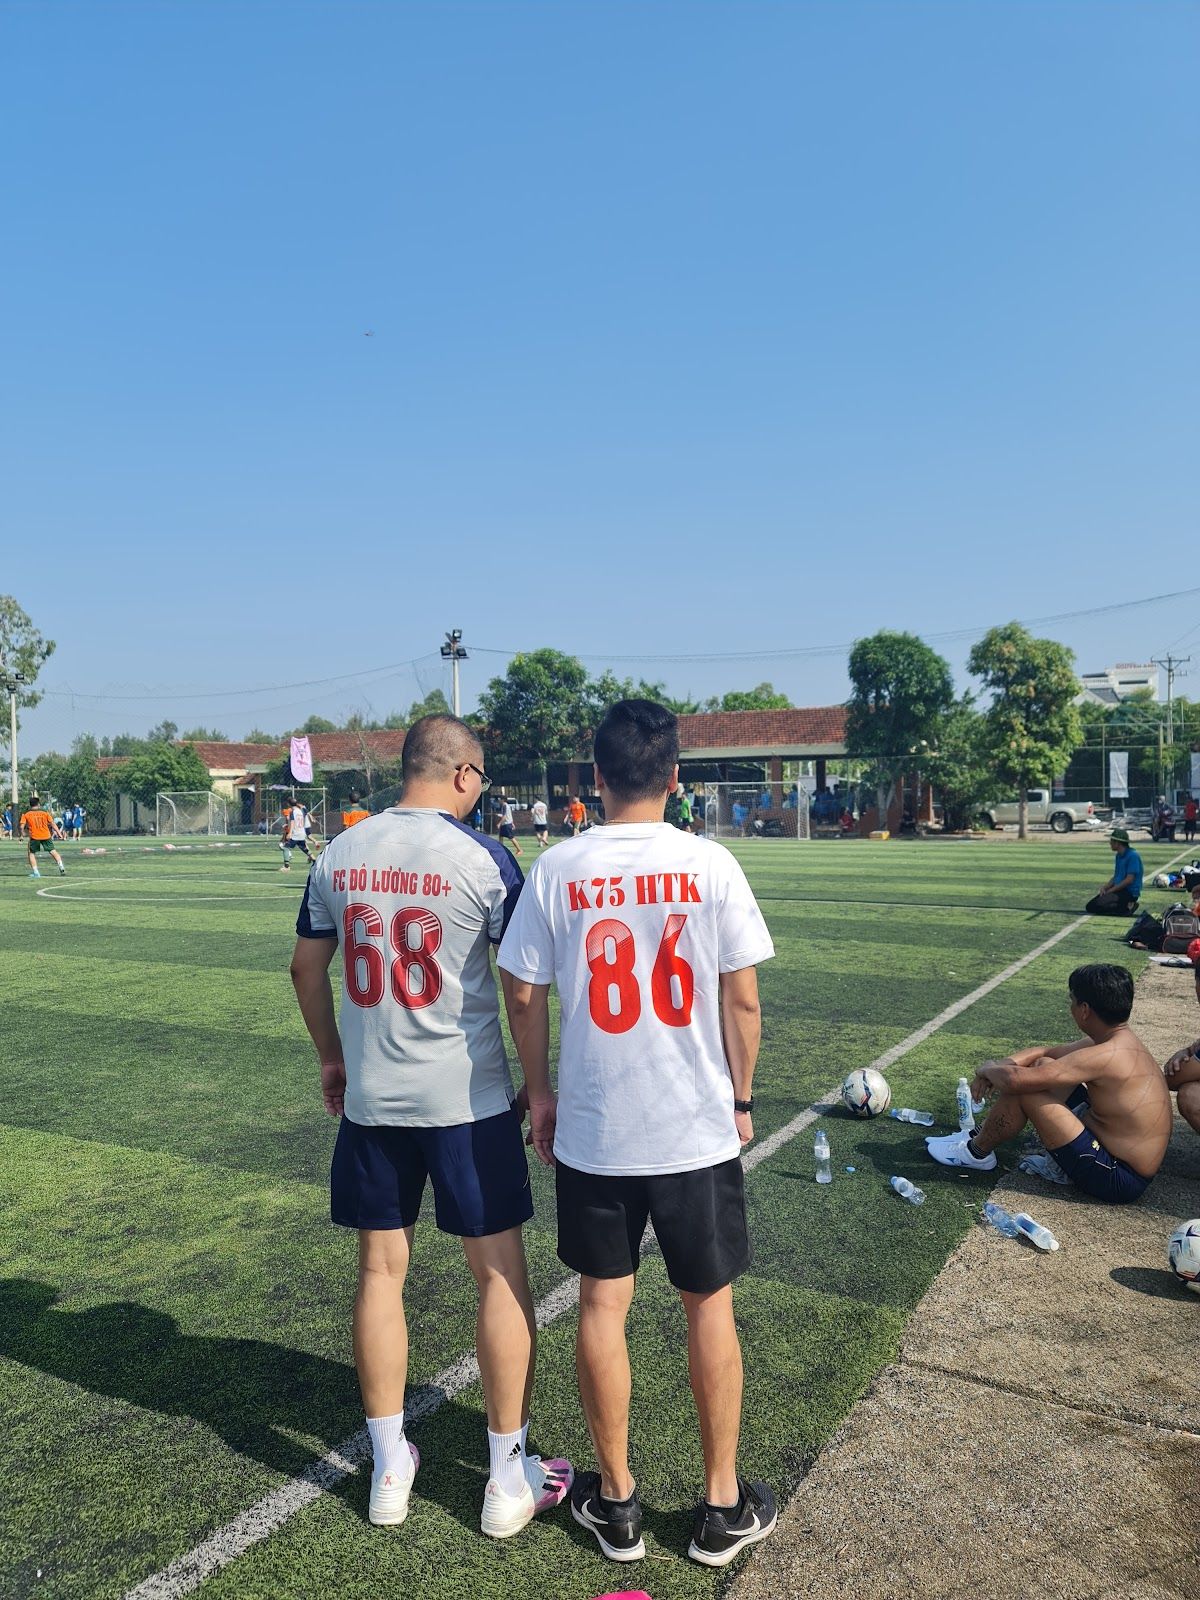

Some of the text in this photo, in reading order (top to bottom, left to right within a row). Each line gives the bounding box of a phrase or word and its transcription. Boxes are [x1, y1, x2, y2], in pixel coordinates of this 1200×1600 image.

[333, 868, 346, 893] FC
[422, 873, 452, 897] 80+
[566, 872, 703, 912] K75 HTK
[343, 902, 442, 1010] 68
[586, 914, 694, 1034] 86
